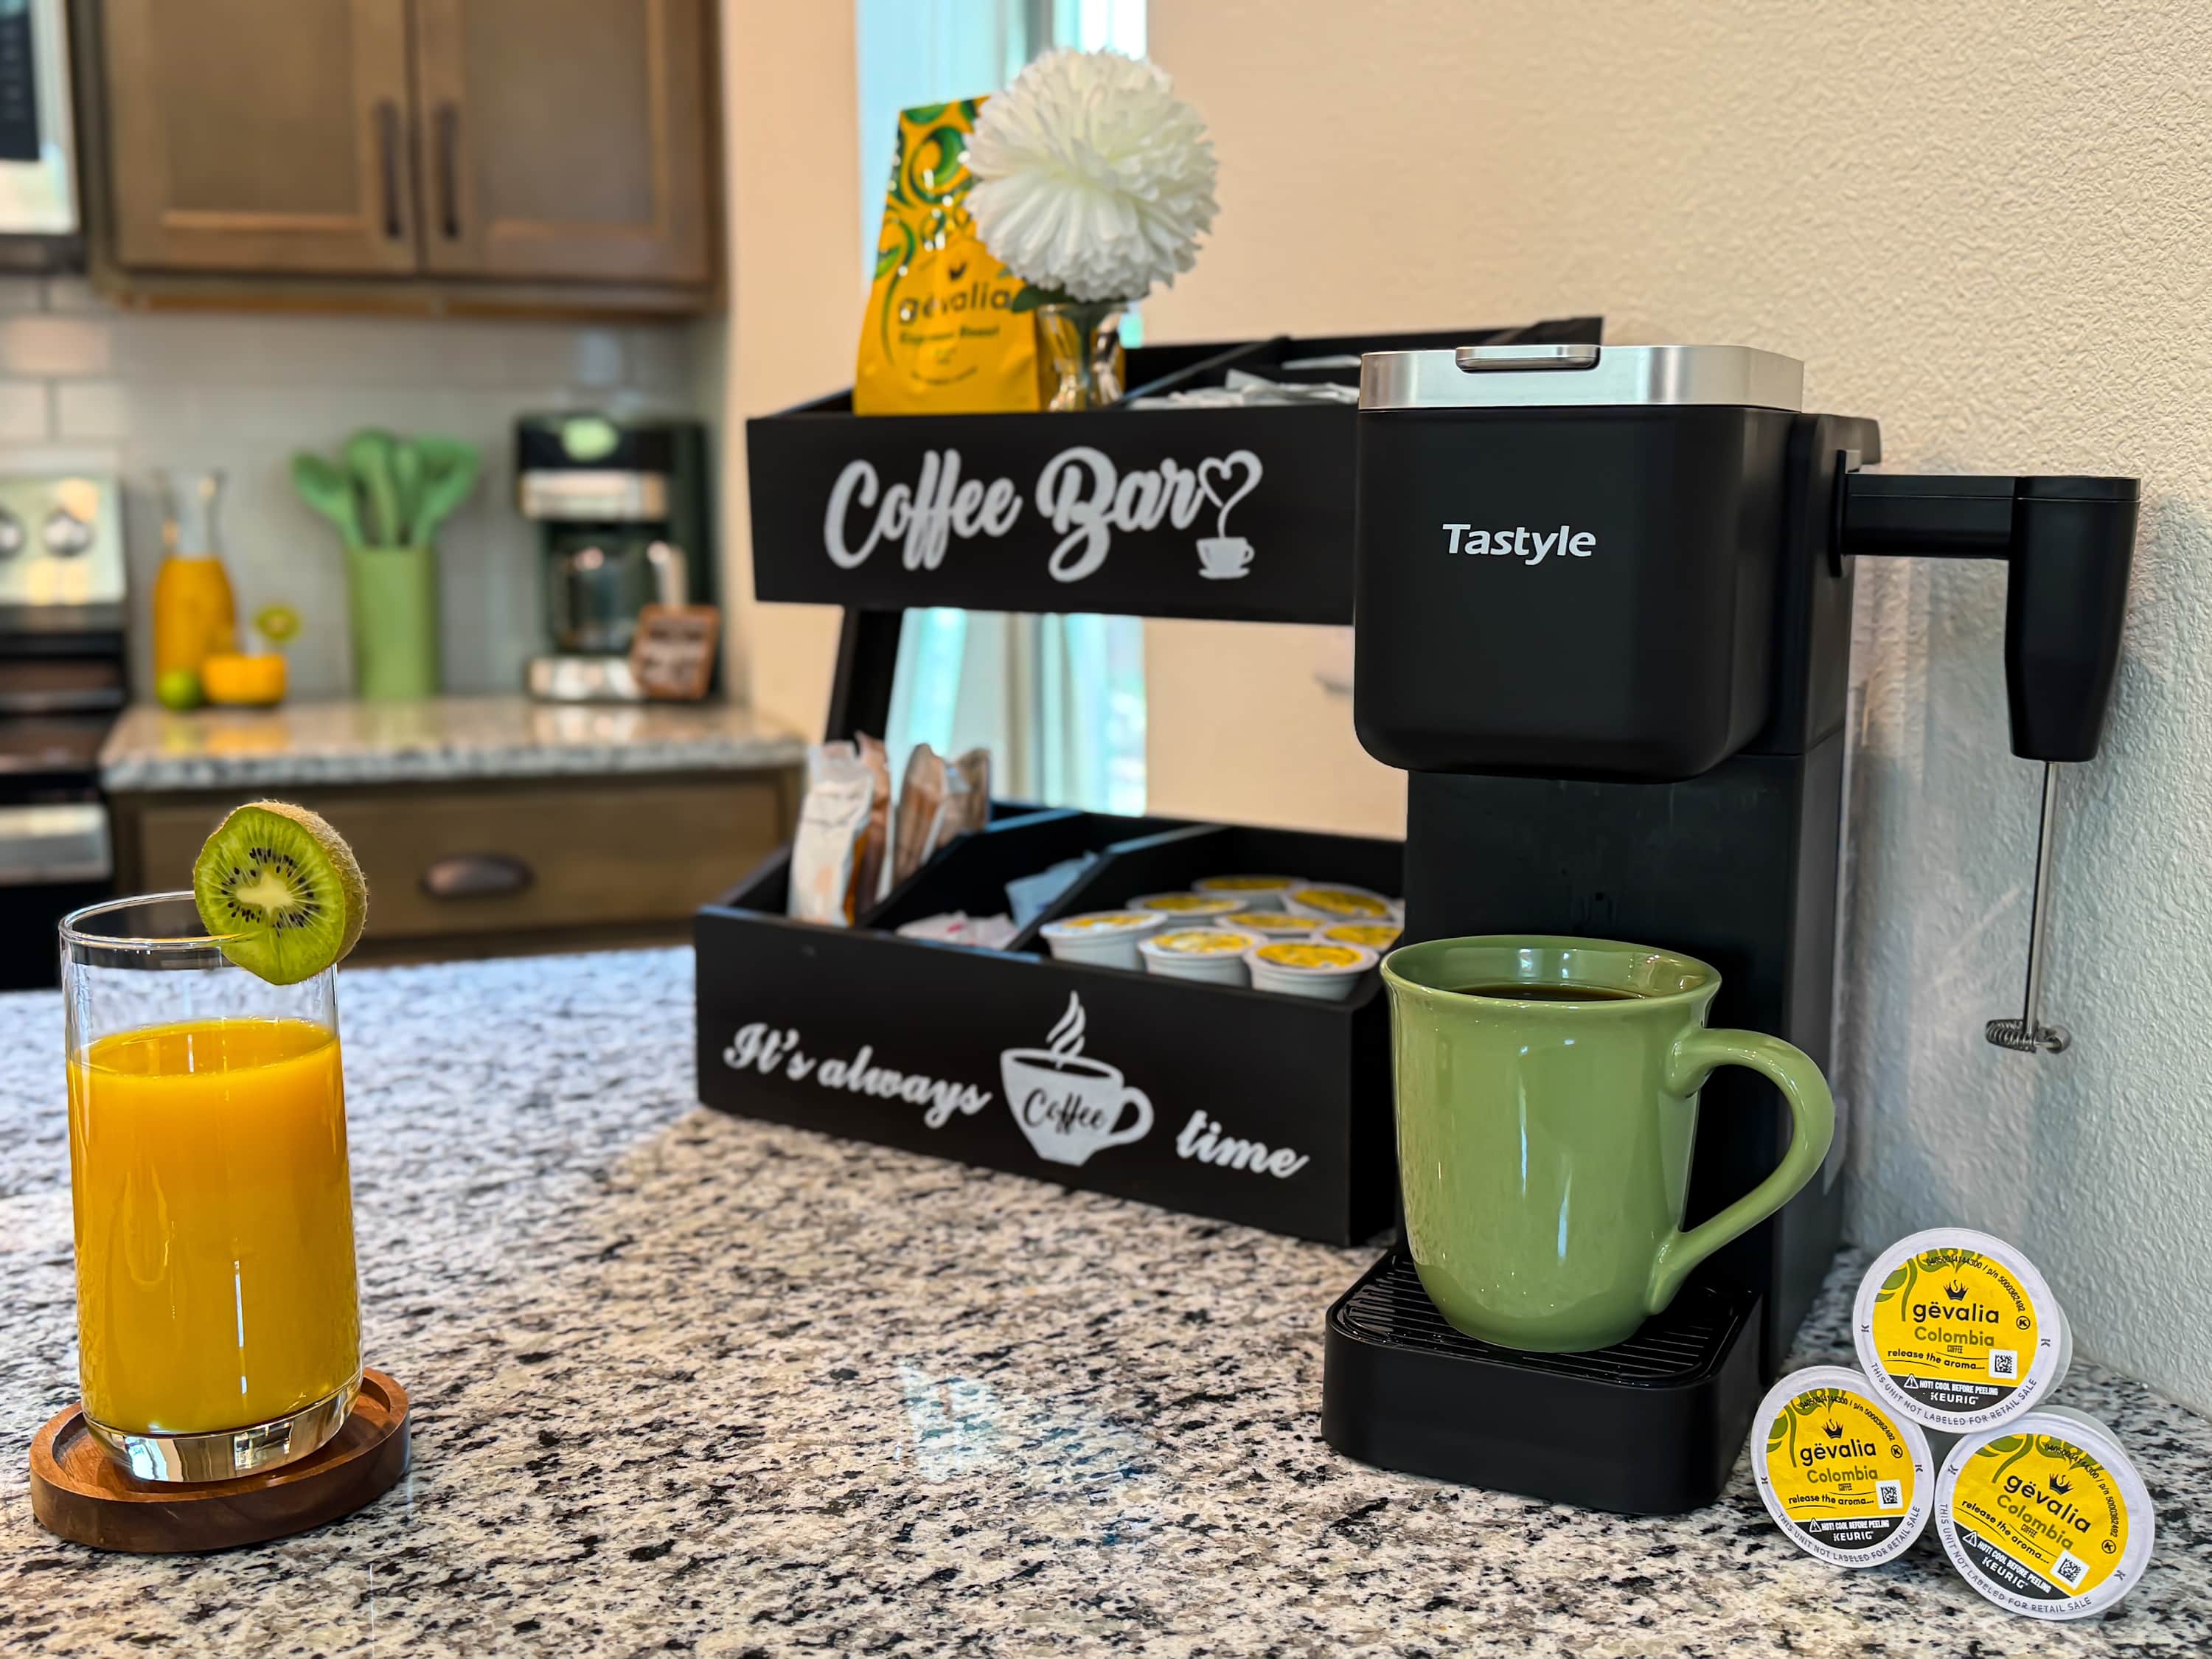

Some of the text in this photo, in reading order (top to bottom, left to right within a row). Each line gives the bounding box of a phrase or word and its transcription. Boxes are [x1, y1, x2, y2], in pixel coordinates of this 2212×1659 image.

[824, 446, 1205, 582] Coffee Bar
[1442, 524, 1596, 566] Tastyle
[723, 1022, 1310, 1178] It's always Coffee time
[1913, 1301, 1999, 1324] gëvalia
[1914, 1326, 1994, 1346] Colombia
[1888, 1349, 1924, 1359] release
[1926, 1352, 1941, 1363] the
[1871, 1363, 2037, 1426] THIS UNIT NOT LABELED FOR RETAIL SALE
[1935, 1382, 1950, 1391] COOL
[1952, 1383, 1974, 1394] BEFORE
[1975, 1386, 1998, 1396] PEELING
[1800, 1439, 1877, 1467] gëvalia
[1807, 1465, 1878, 1484] Colombia
[1789, 1494, 1820, 1504] release
[1822, 1494, 1836, 1503] the
[2003, 1475, 2092, 1534] gëvalia
[1778, 1506, 1920, 1562] THIS UNIT NOT LABELED FOR RETAIL SALE
[1835, 1522, 1848, 1530] COOL
[1848, 1520, 1868, 1529] BEFORE
[1962, 1500, 1996, 1523] release
[1997, 1521, 2011, 1536] the
[1997, 1494, 2073, 1550] Colombia
[2020, 1524, 2038, 1539] COFFEE
[1940, 1504, 2092, 1613] THIS UNIT NOT LABELED FOR RETAIL SALE
[1992, 1549, 2008, 1564] COOL
[2007, 1559, 2028, 1578] BEFORE
[2028, 1571, 2051, 1593] PEELING
